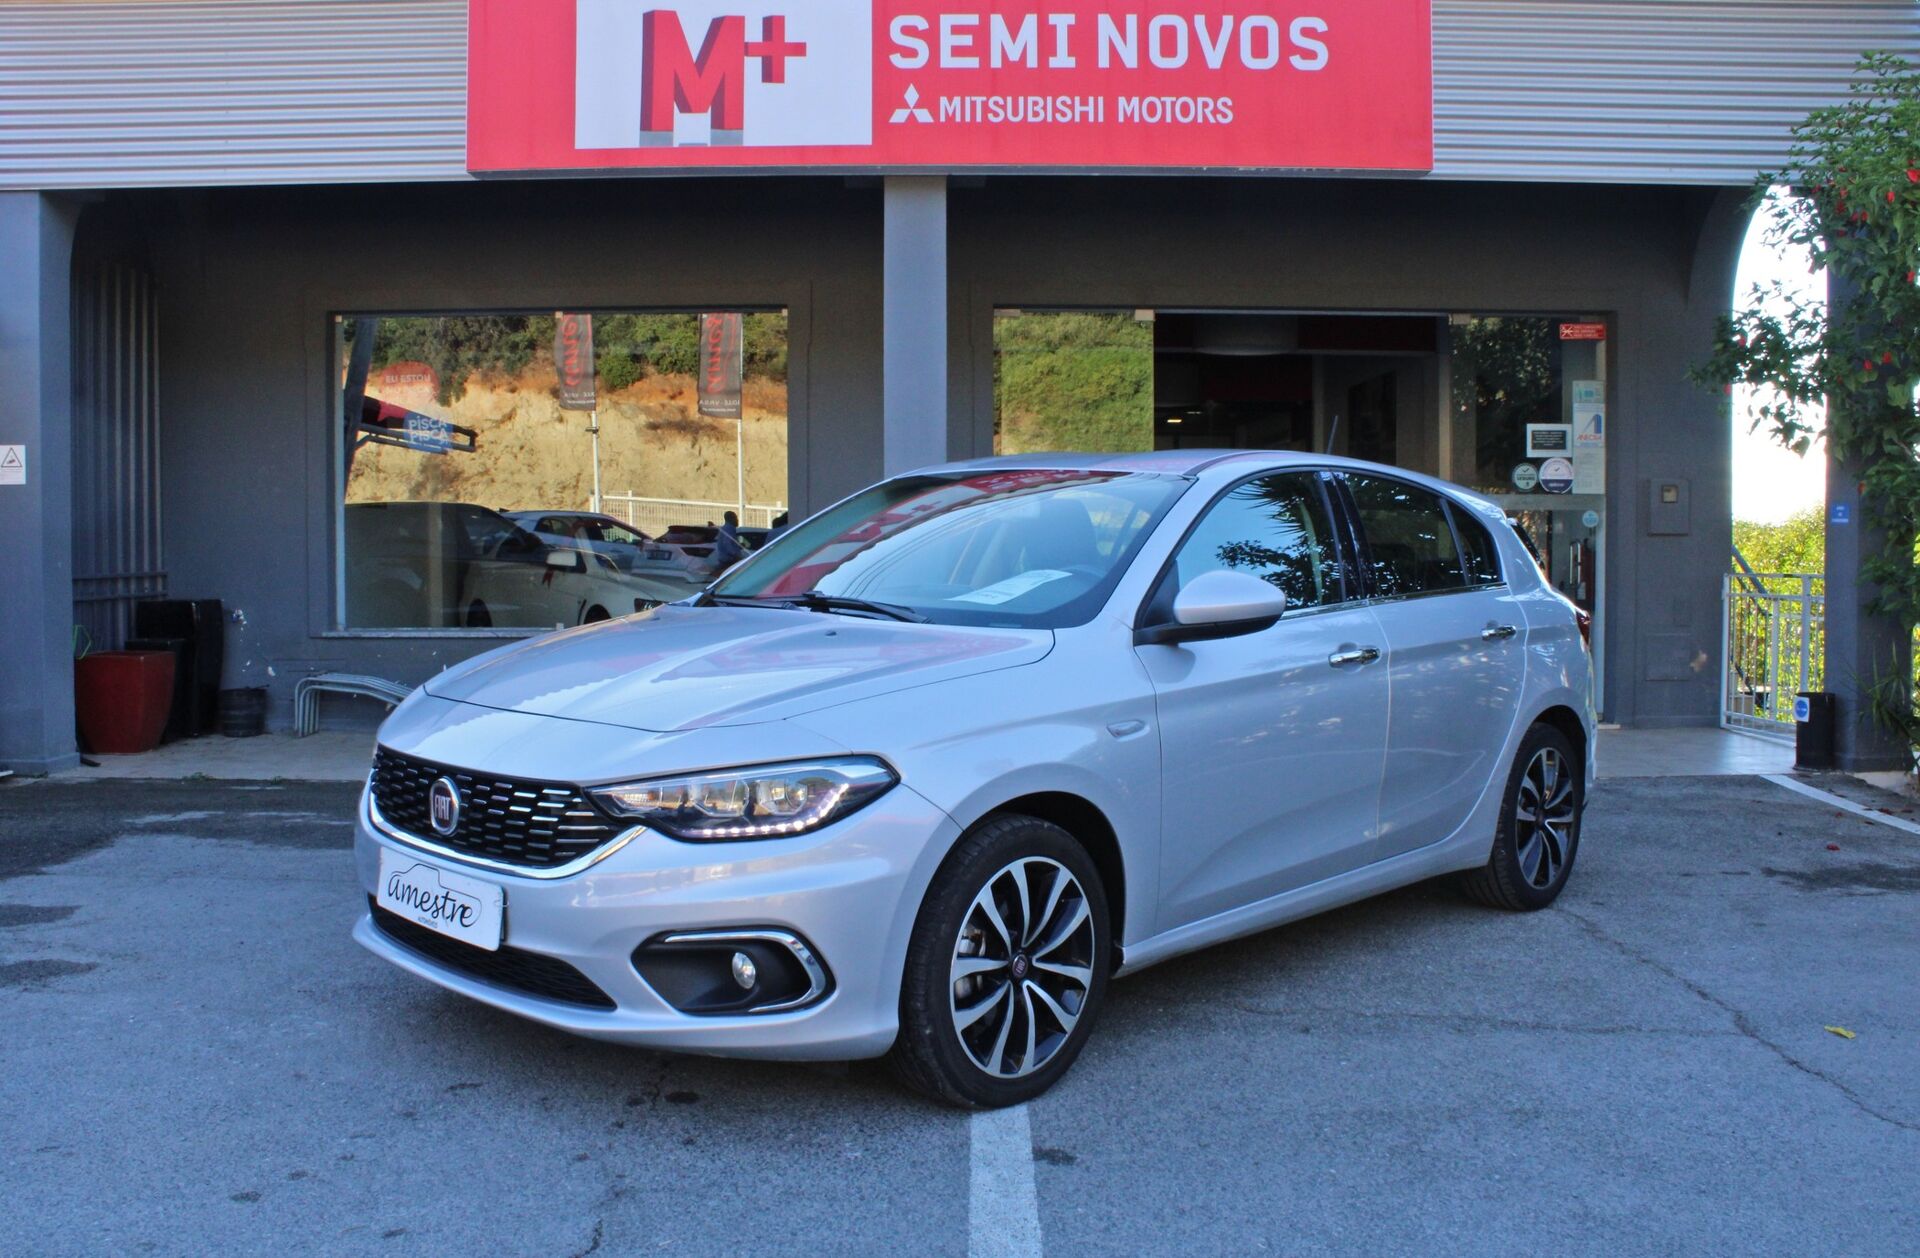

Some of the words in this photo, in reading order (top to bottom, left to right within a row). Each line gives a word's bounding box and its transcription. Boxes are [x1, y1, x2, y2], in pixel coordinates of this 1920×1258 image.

[888, 13, 1076, 70] SEMI
[1098, 14, 1329, 71] NOVOS
[939, 95, 1104, 123] MITSUBISHI
[1117, 95, 1234, 123] MOTORS
[434, 794, 451, 820] FIAT
[387, 874, 474, 928] amestre
